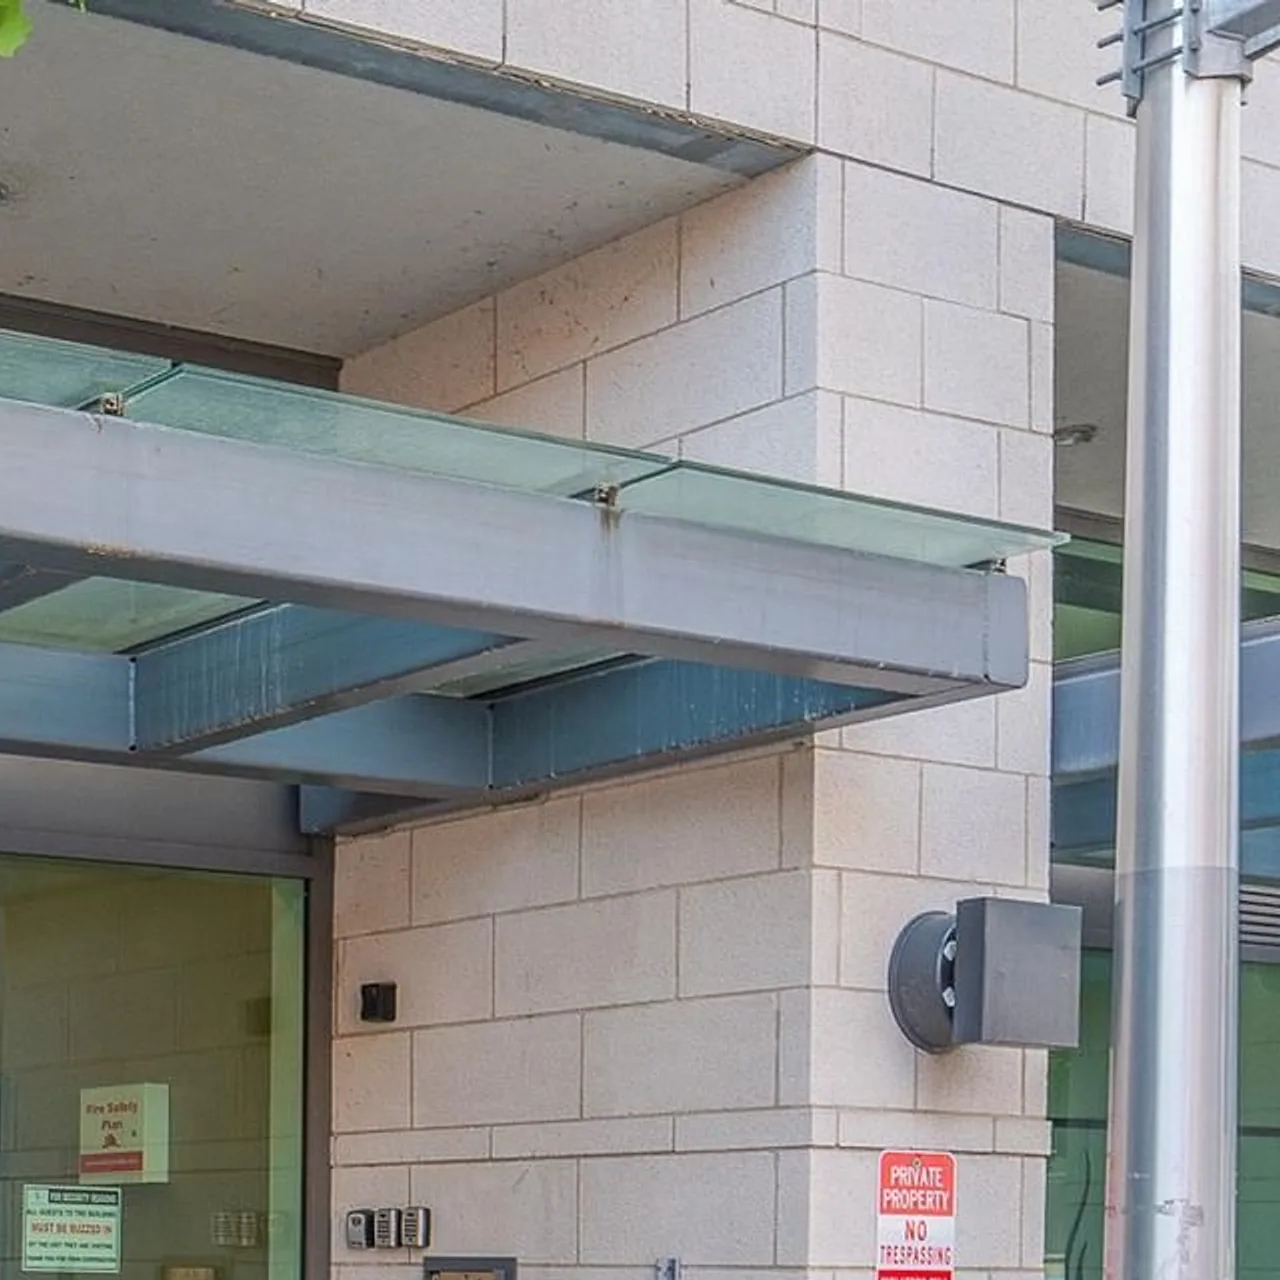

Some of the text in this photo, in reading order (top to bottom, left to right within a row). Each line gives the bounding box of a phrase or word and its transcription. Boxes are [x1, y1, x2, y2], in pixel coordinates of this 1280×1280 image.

[890, 1165, 944, 1187] PRIVATE
[882, 1189, 951, 1211] PROPERTY
[904, 1219, 928, 1242] NO
[880, 1245, 952, 1266] TRESPASSING
